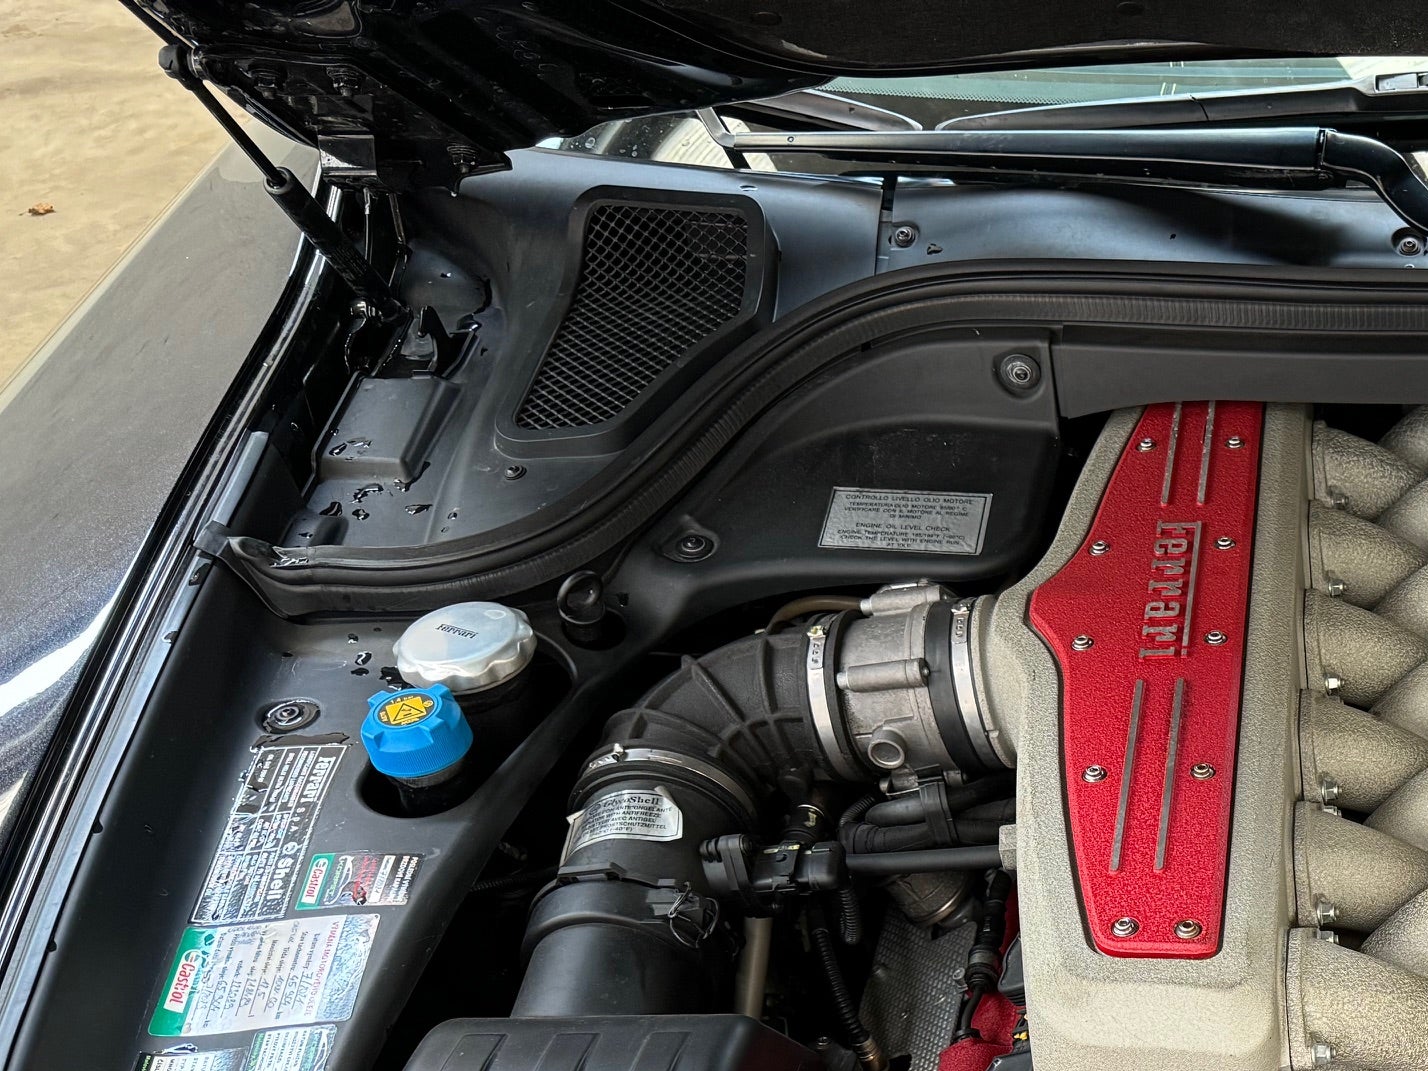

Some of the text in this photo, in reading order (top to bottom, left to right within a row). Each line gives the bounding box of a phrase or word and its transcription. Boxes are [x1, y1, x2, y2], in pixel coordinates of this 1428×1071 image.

[1139, 520, 1202, 659] Ferrari
[435, 623, 478, 640] Ferrari
[299, 756, 336, 802] Ferrari
[622, 810, 662, 818] ANTIFREEZE
[264, 857, 295, 899] Shell
[303, 868, 324, 897] Castrol
[167, 962, 197, 1004] Castrol
